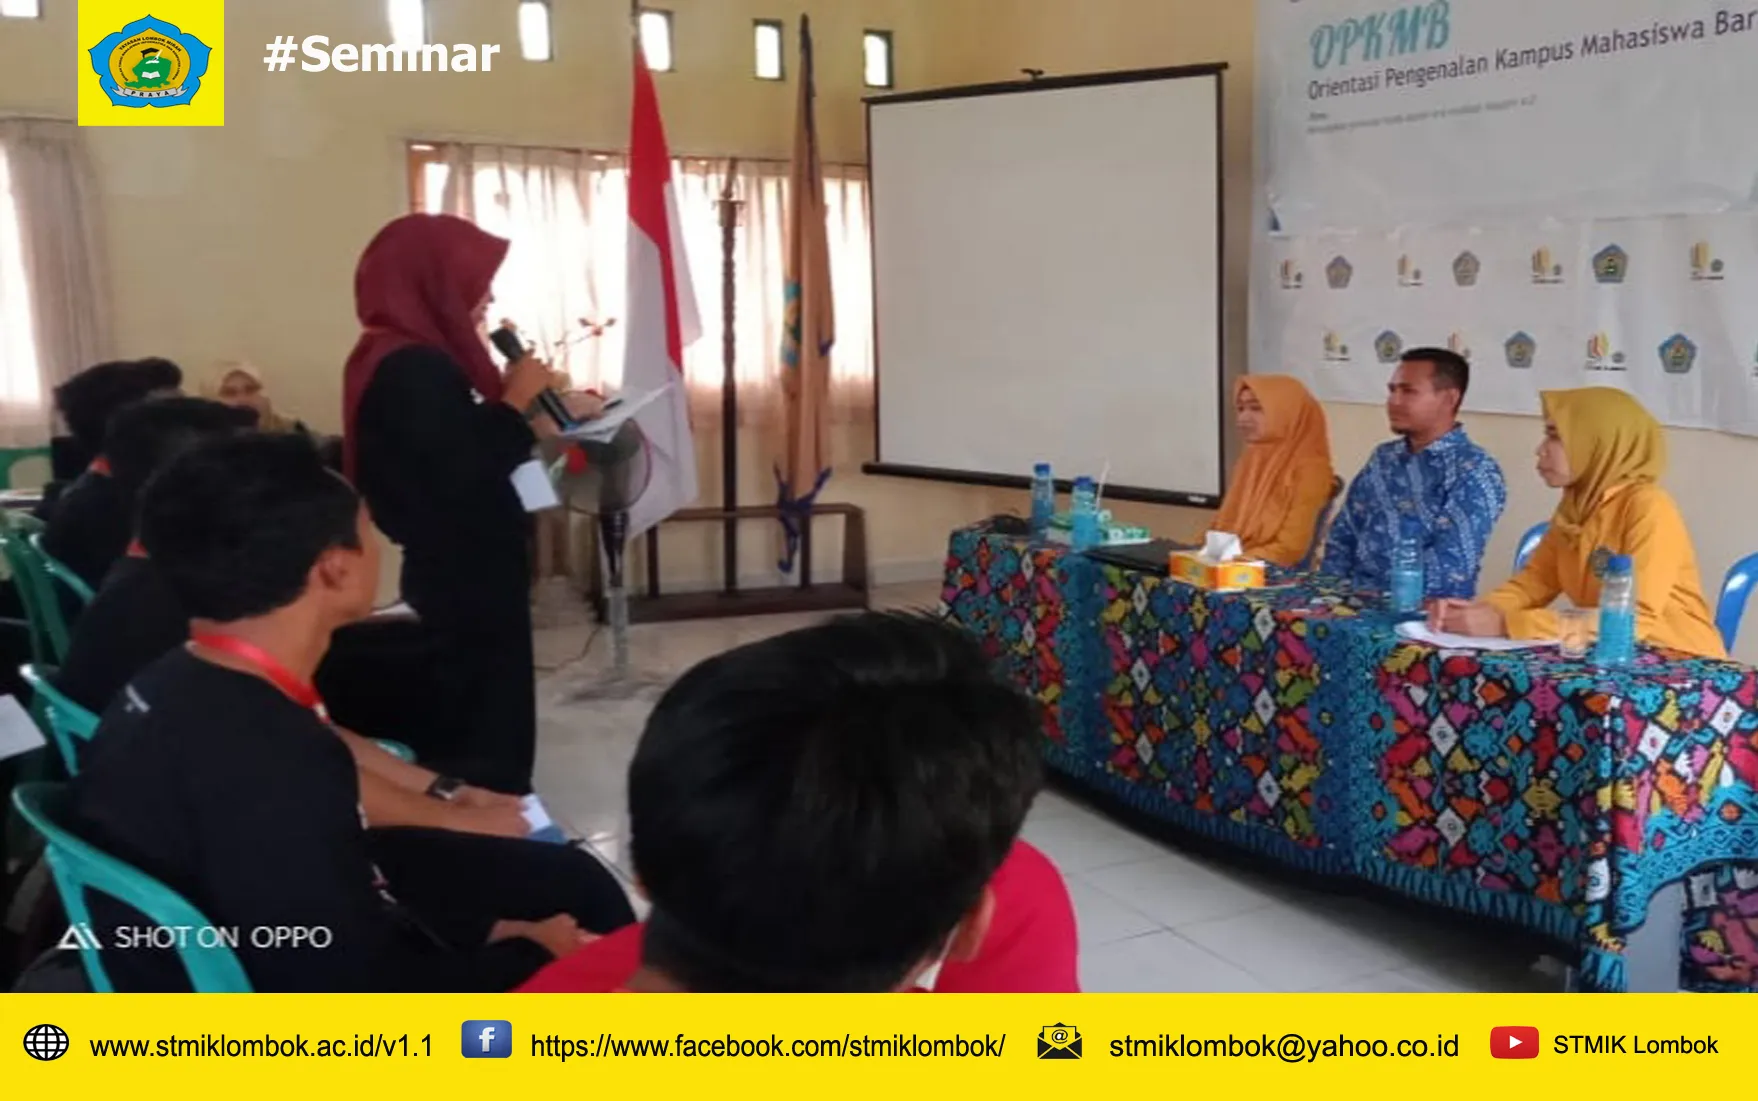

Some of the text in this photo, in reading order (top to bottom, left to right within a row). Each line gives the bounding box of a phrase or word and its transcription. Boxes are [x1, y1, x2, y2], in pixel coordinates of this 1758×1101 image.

[1308, 70, 1380, 100] Orientasi
[1385, 54, 1488, 88] Pengenalan
[1495, 40, 1574, 70] Kampus
[1580, 18, 1705, 55] Mahasiswa
[1310, 0, 1451, 69] OPKMB
